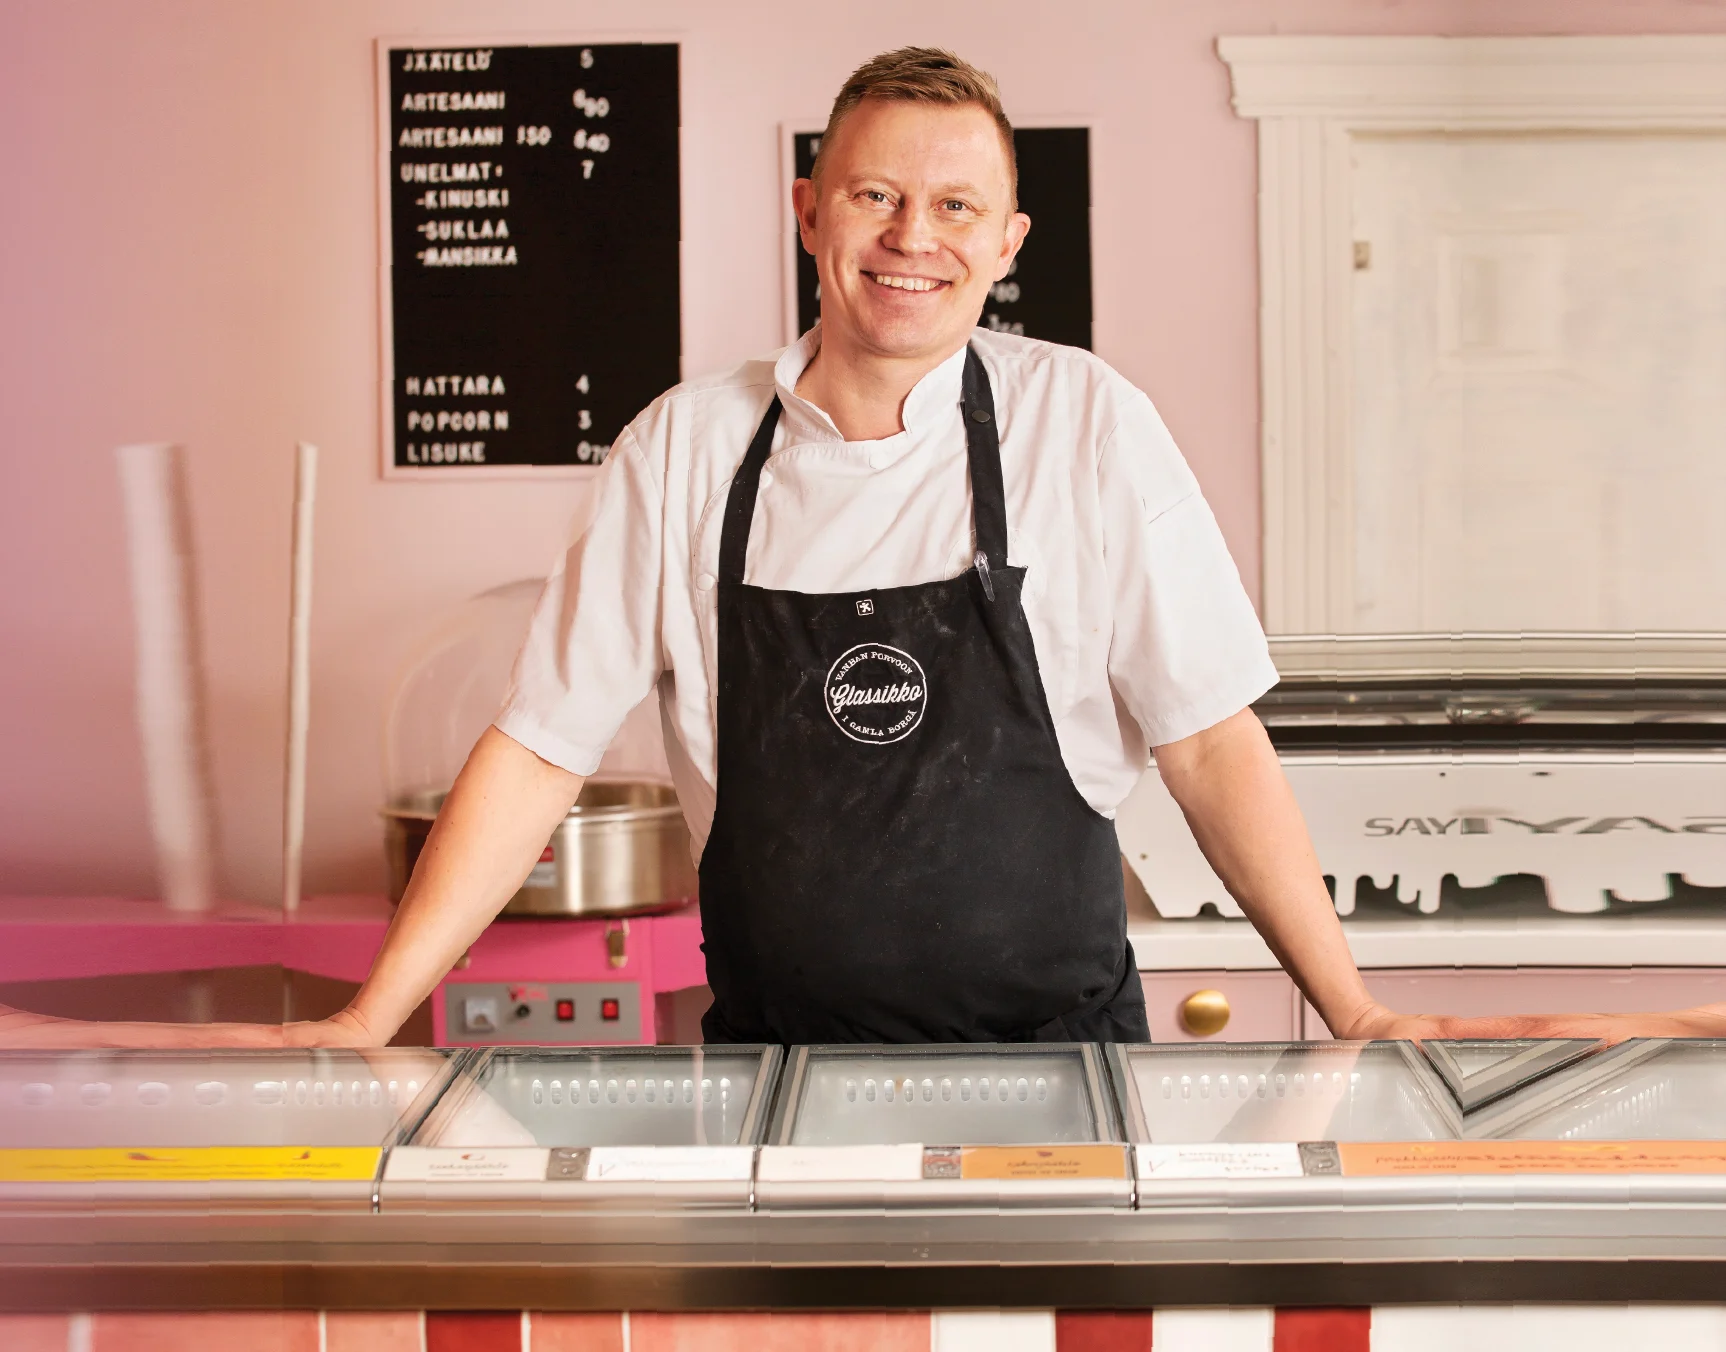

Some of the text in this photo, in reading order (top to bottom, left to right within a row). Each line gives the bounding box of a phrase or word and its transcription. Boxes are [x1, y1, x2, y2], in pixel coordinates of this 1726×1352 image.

[402, 92, 505, 111] ARTESAANI
[399, 127, 503, 148] ARTESAANI
[582, 160, 594, 179] 7
[406, 375, 589, 395] HATTARA 4
[408, 410, 591, 431] POPCORN 3
[408, 442, 485, 462] LISUKE
[835, 651, 913, 681] VANHAN PORVOON
[830, 682, 923, 714] Glassikko
[850, 722, 885, 736] GAMLA
